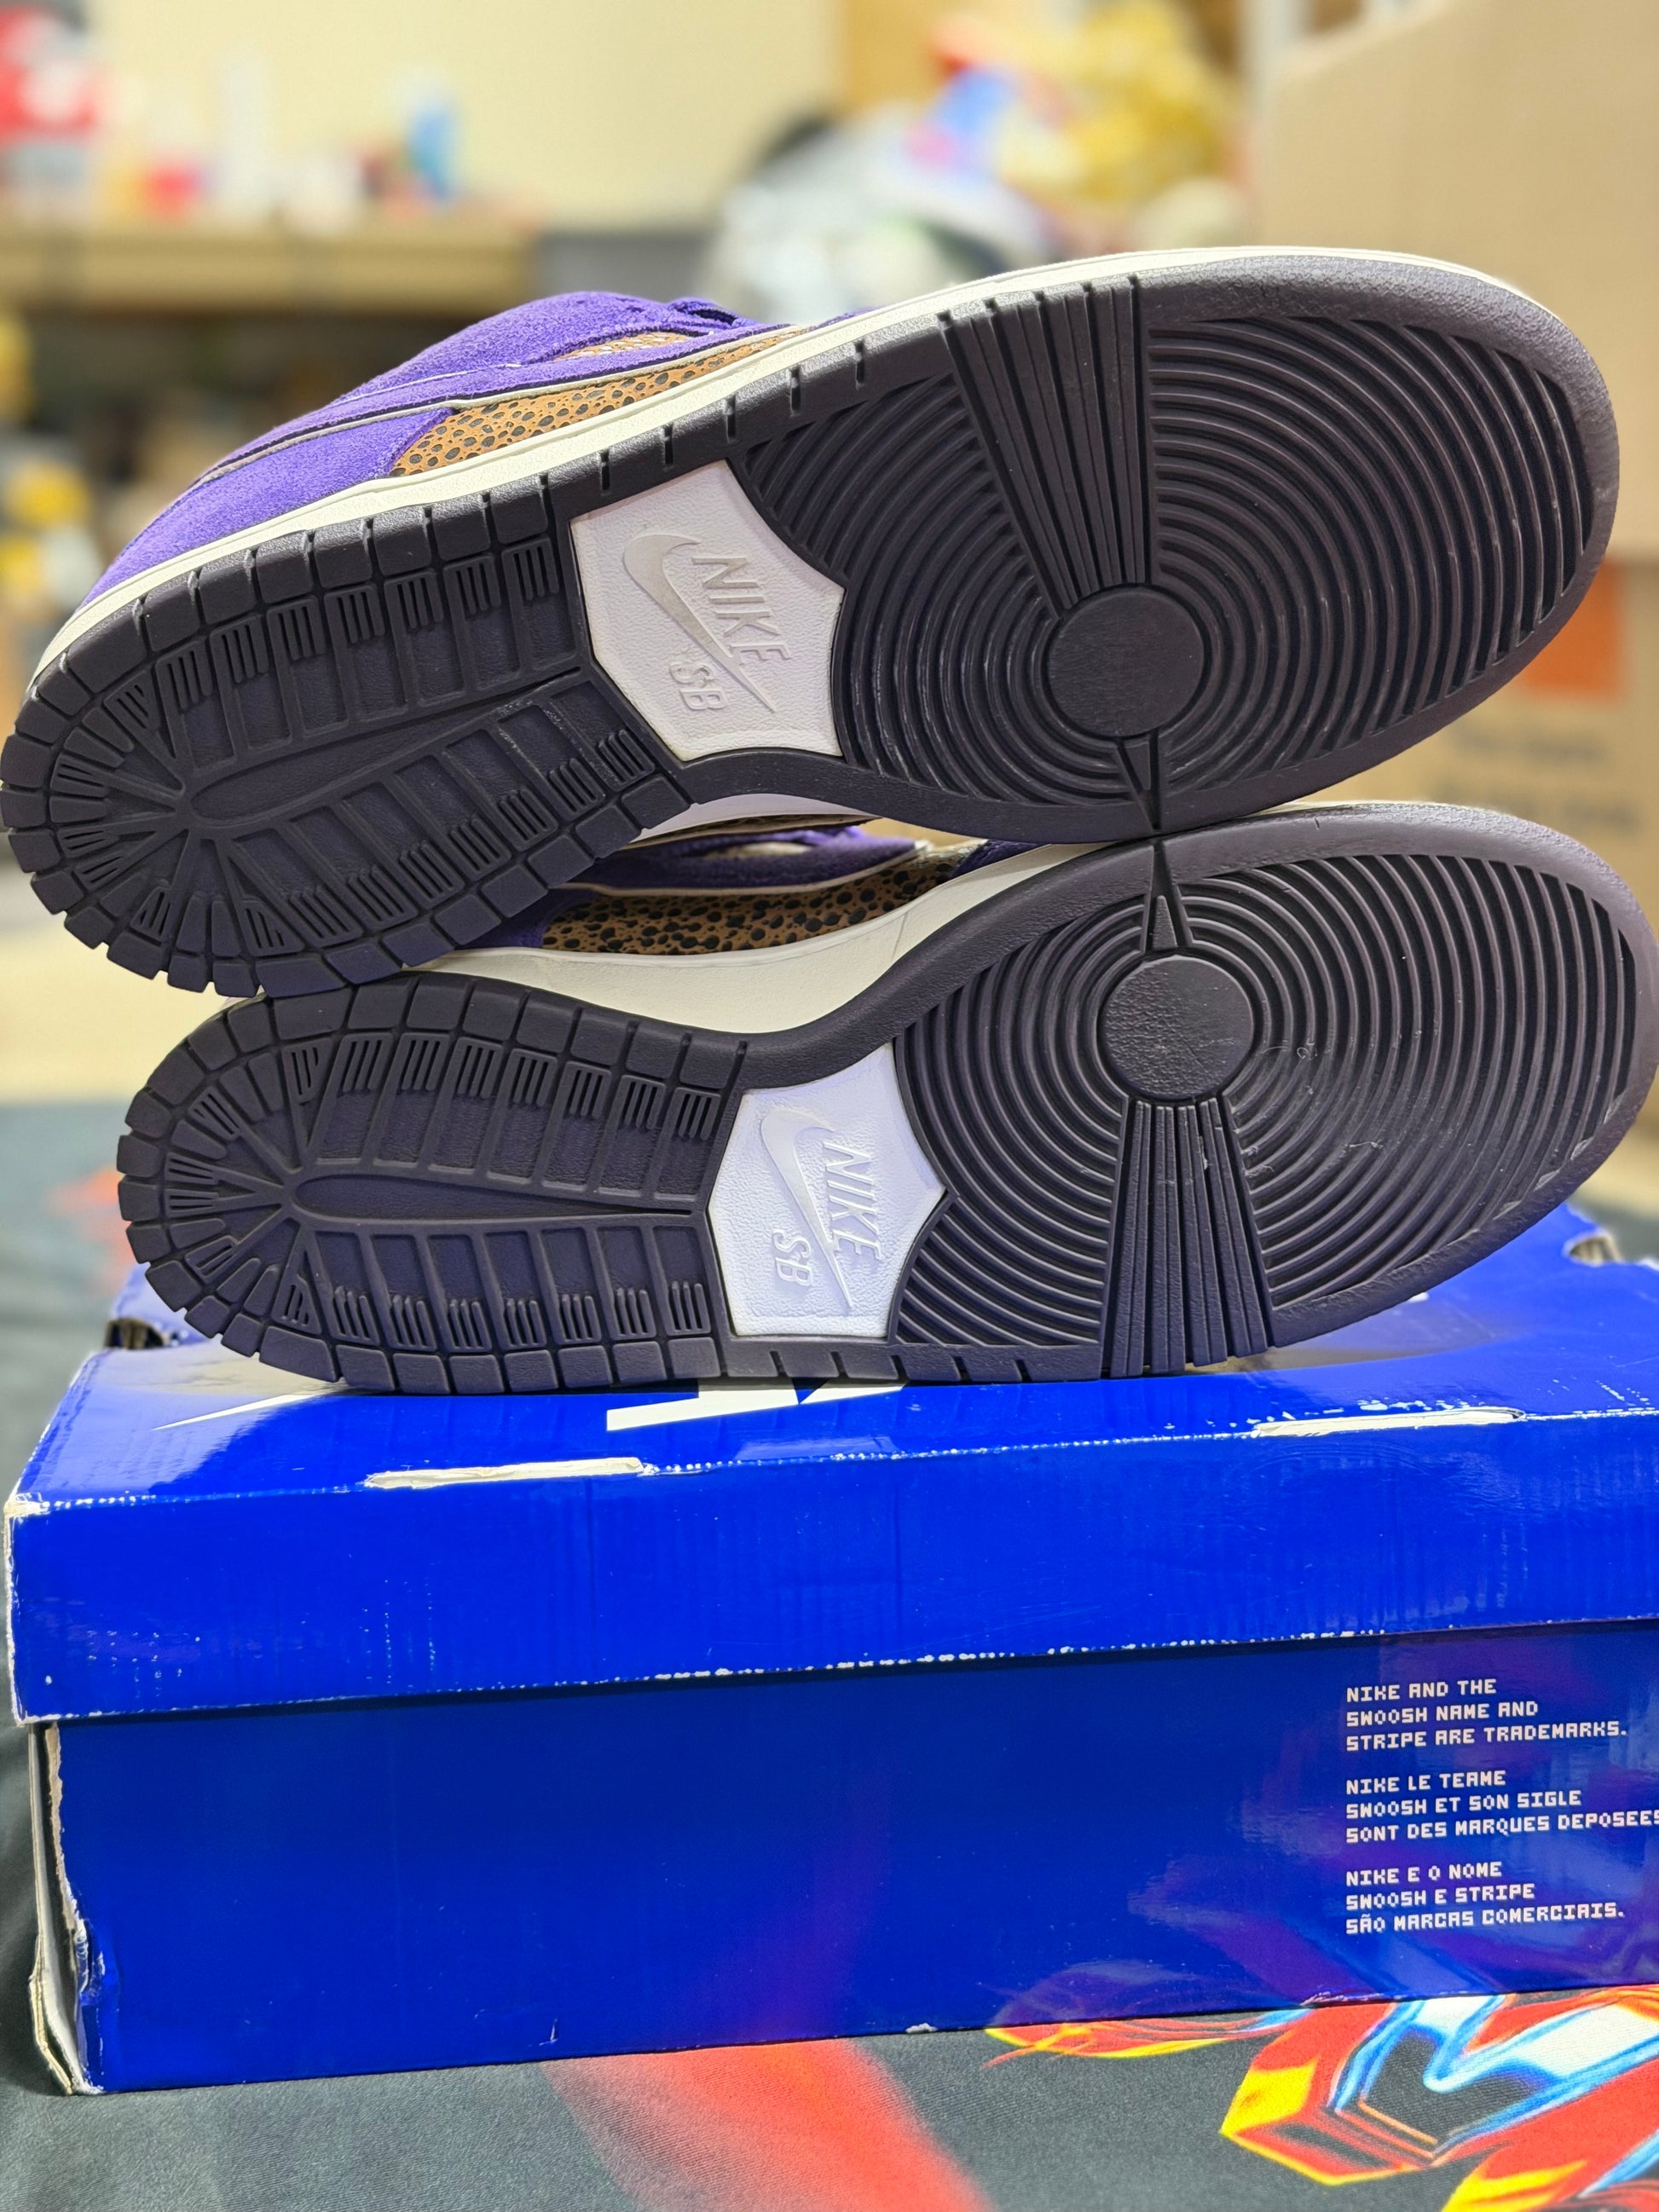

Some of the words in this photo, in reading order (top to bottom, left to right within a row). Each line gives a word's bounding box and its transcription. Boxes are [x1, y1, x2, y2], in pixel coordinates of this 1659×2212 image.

[691, 557, 792, 666] NIKE
[668, 661, 728, 711] SB
[822, 1139, 883, 1261] NIKE
[771, 1228, 812, 1286] SB
[1346, 1684, 1401, 1703] NIKE
[1408, 1681, 1448, 1699] AND
[1457, 1678, 1496, 1695] THE
[1346, 1707, 1428, 1727] SWOOSH
[1436, 1703, 1489, 1721] NAME
[1498, 1701, 1538, 1718] AND
[1346, 1731, 1427, 1752] STRIPE
[1435, 1728, 1475, 1746] ARE
[1483, 1720, 1627, 1742] TRADEMARKS.
[1346, 1776, 1400, 1795] NIKE
[1408, 1775, 1431, 1791] LE
[1346, 1799, 1427, 1819] SWOOSH
[1435, 1797, 1461, 1813] ET
[1469, 1793, 1509, 1811] SON
[1517, 1789, 1581, 1808] SIGLE
[1346, 1825, 1399, 1844] SONT
[1407, 1822, 1447, 1839] DES
[1455, 1815, 1550, 1837] MARQUES
[1346, 1868, 1400, 1887] NIKE
[1408, 1866, 1420, 1883] E
[1428, 1865, 1441, 1881] O
[1448, 1861, 1502, 1880] NOME
[1346, 1890, 1427, 1911] SWOOSH
[1434, 1888, 1448, 1905] E
[1455, 1883, 1535, 1903] STRIPE
[1345, 1913, 1386, 1935] SÃO
[1394, 1910, 1475, 1932] MARCAS
[1482, 1902, 1625, 1926] COMERCIAIS.
